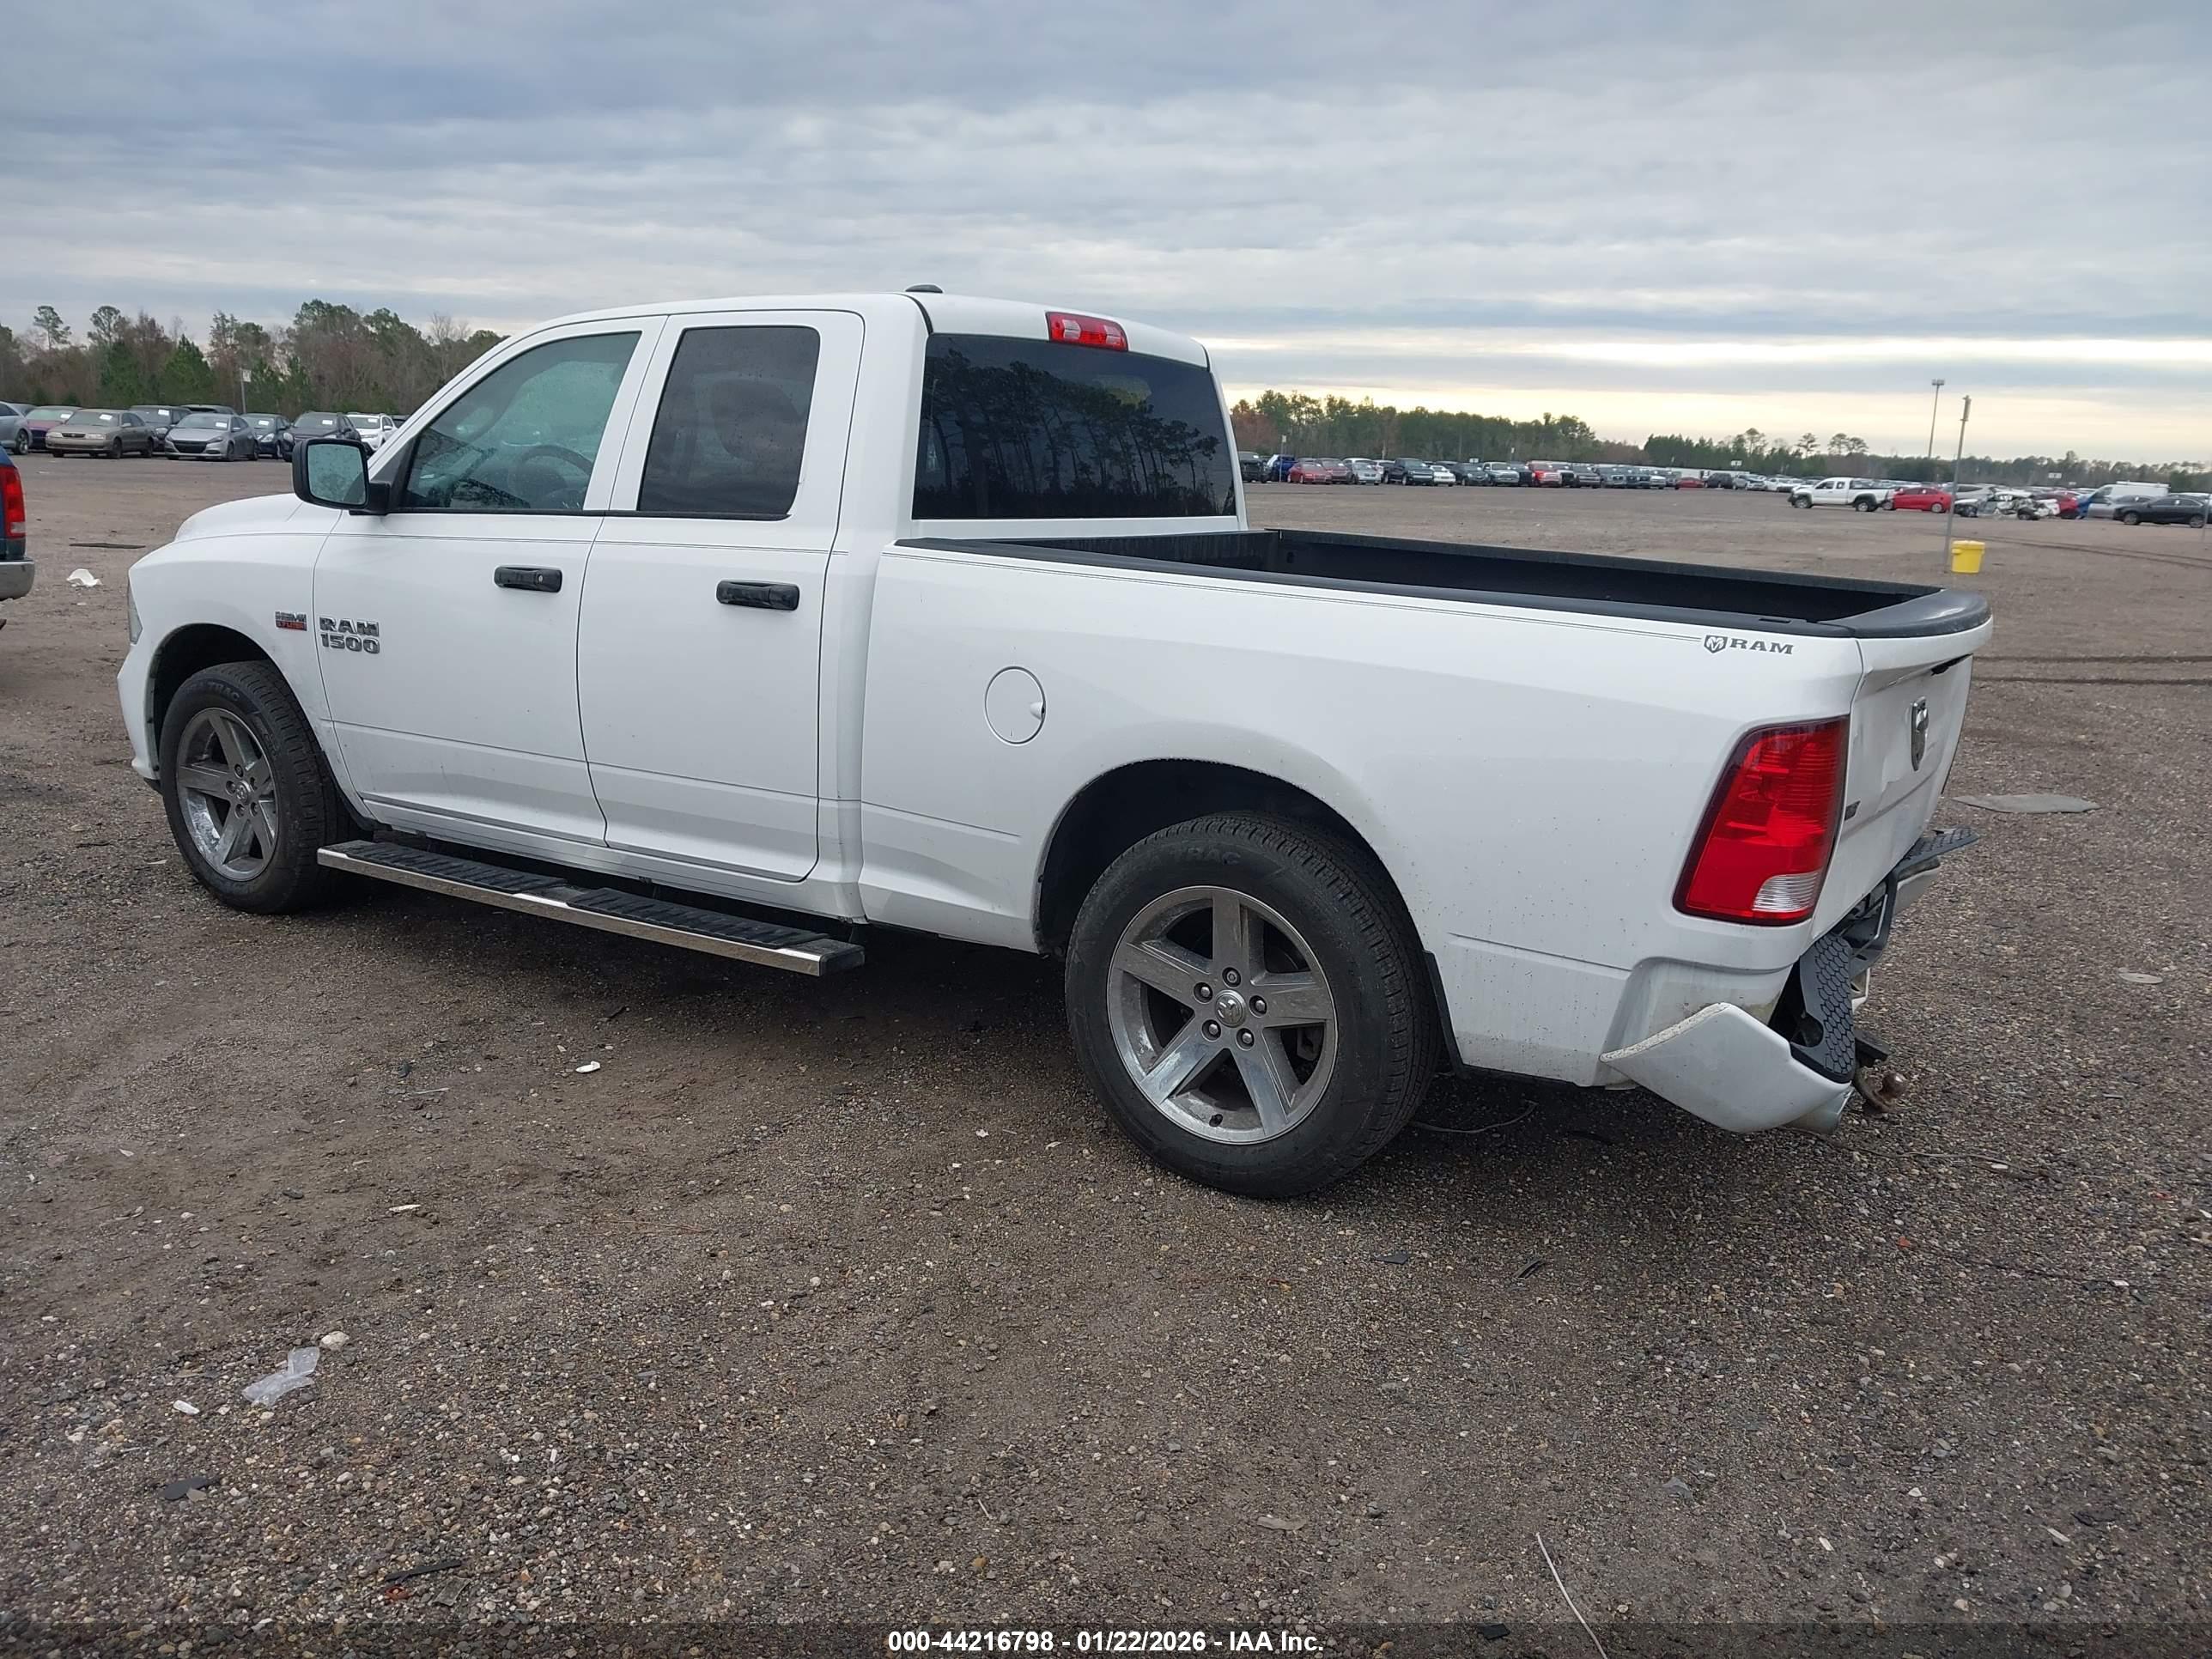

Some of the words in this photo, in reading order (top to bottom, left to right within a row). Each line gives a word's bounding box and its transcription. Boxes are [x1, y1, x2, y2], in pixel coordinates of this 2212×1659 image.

[319, 617, 380, 637] RAM
[320, 633, 380, 654] 1500
[1729, 637, 1795, 654] RAM
